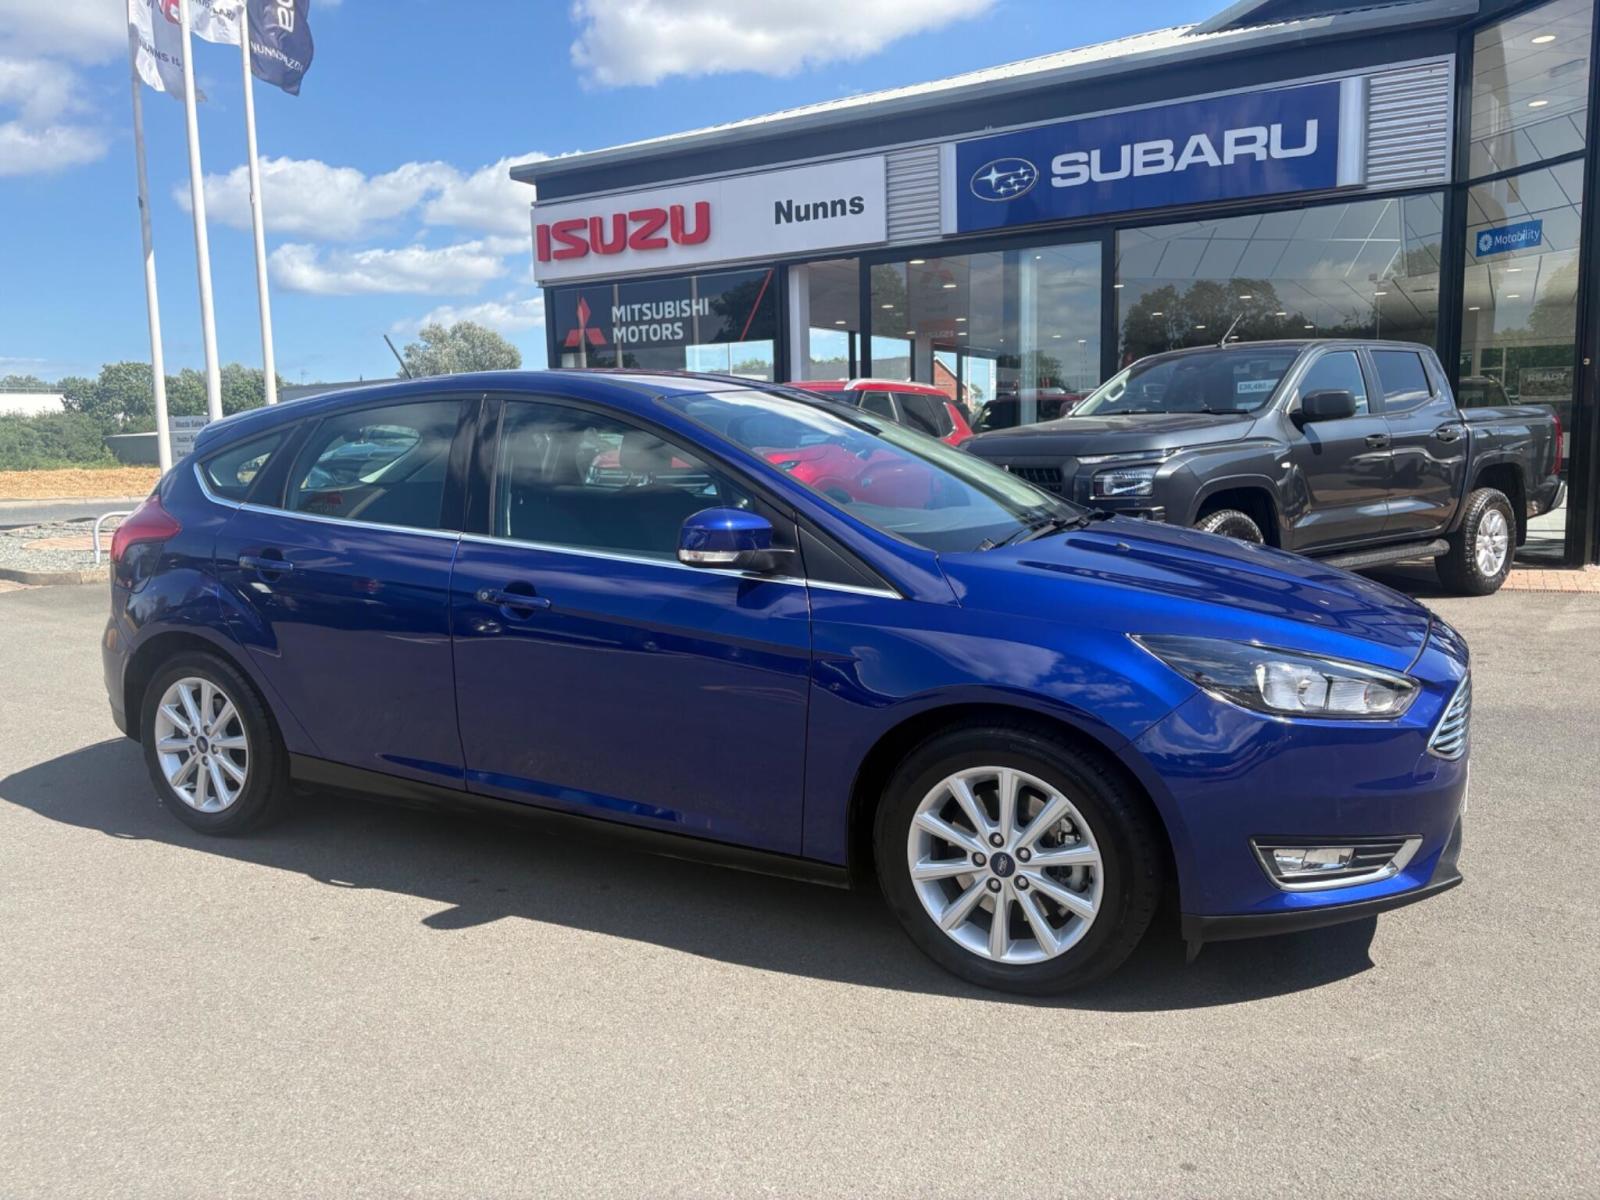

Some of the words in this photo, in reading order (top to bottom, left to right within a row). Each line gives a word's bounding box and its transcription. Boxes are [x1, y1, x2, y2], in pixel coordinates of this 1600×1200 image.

[1051, 119, 1318, 188] SUBARU
[775, 195, 865, 225] Nunns
[536, 201, 710, 262] ISUZU
[1494, 229, 1541, 247] Motability
[612, 298, 709, 323] MITSUBISHI
[613, 322, 684, 344] MOTORS
